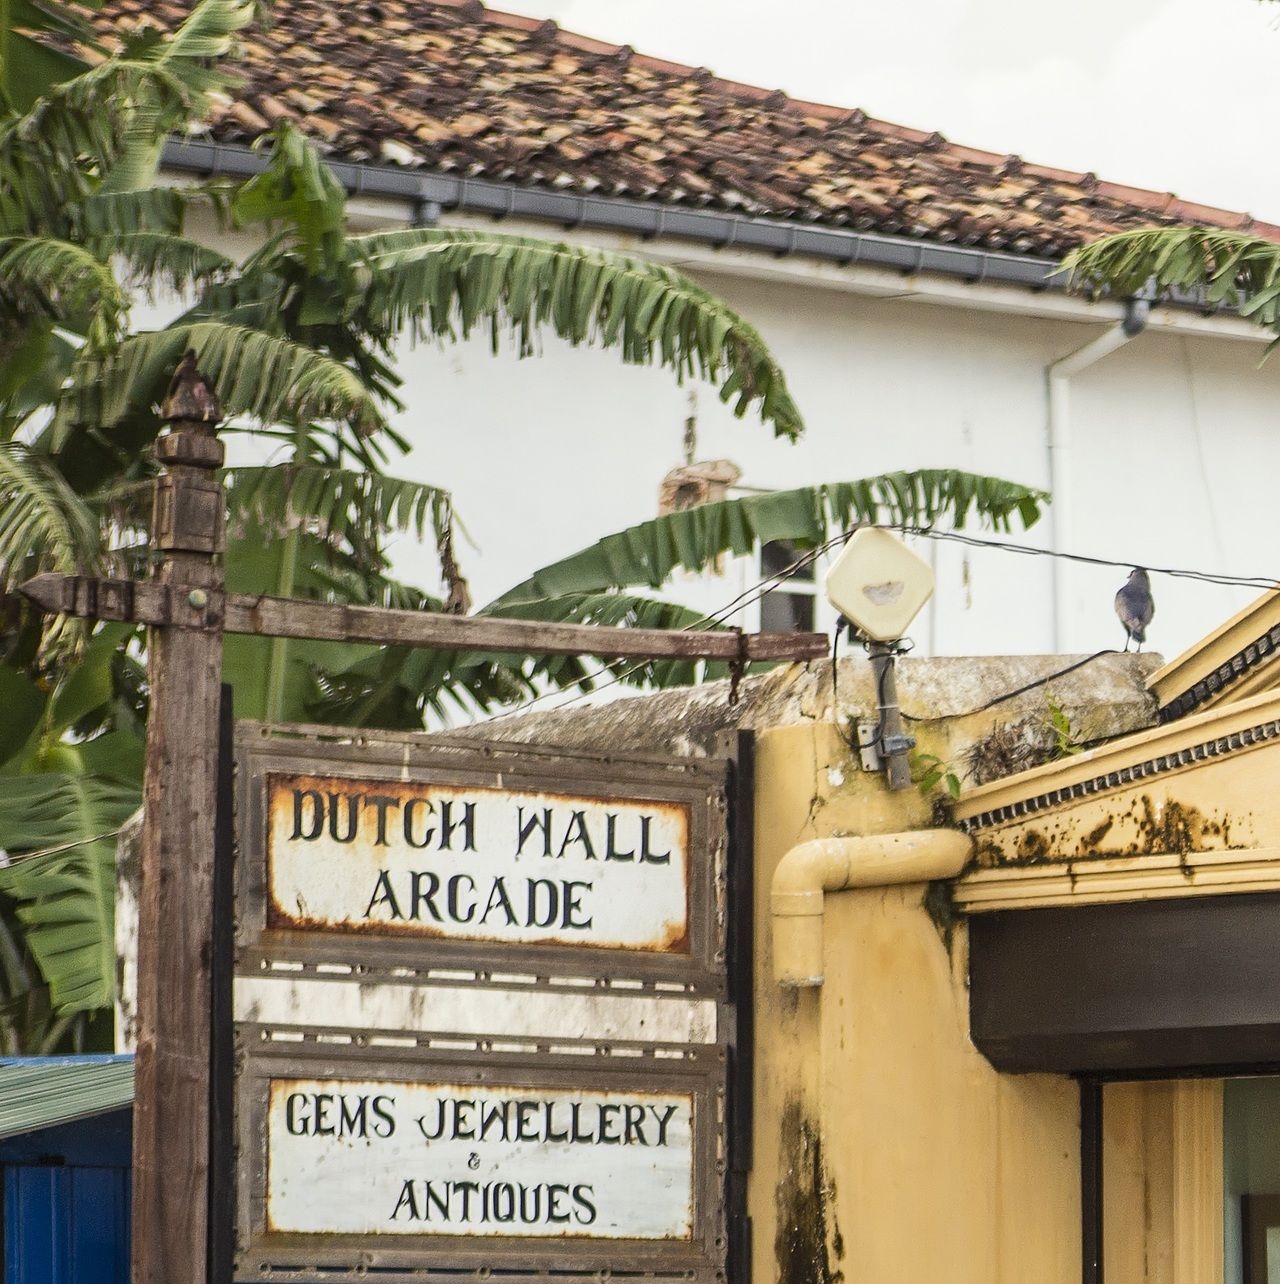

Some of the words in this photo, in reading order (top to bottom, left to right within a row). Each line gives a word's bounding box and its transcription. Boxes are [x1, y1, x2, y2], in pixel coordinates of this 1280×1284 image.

[289, 789, 477, 852] DUTCH
[514, 806, 671, 865] WALL
[362, 869, 593, 930] ARCADE
[285, 1092, 396, 1139] GEMS
[414, 1099, 679, 1147] JEWELLERY
[467, 1151, 480, 1170] &
[389, 1179, 597, 1225] ANTIQUES
